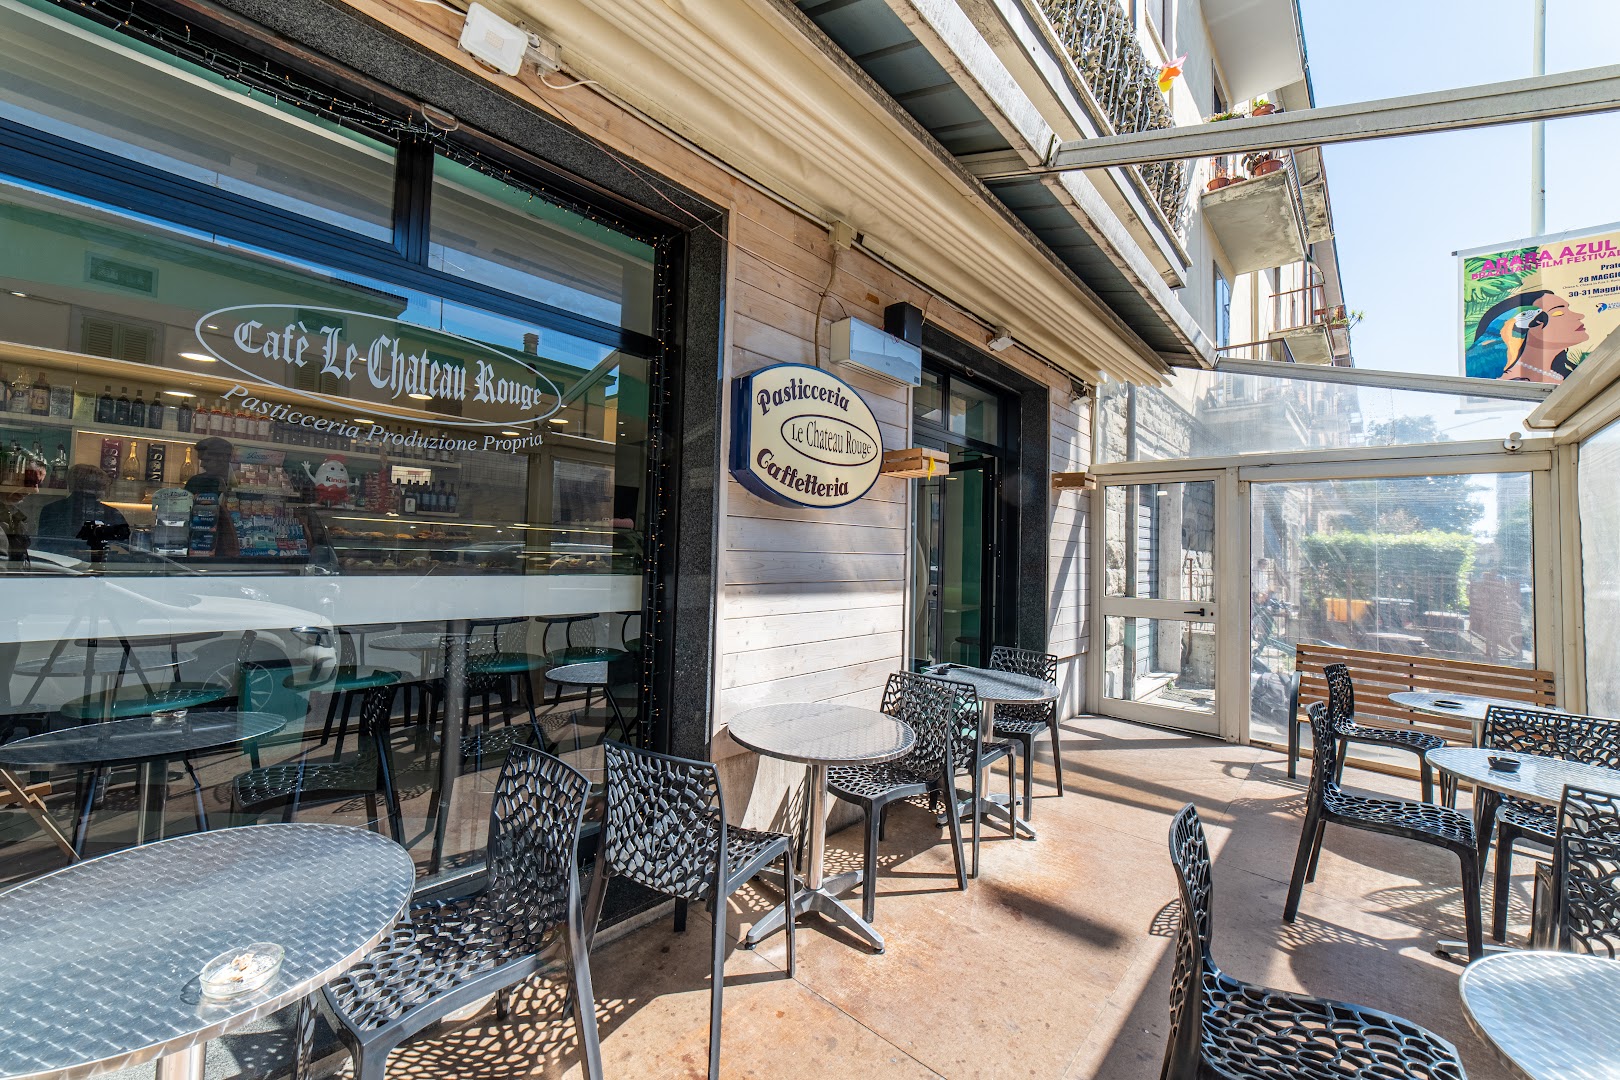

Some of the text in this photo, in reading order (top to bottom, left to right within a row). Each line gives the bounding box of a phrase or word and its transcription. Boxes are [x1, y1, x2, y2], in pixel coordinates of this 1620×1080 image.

[1472, 264, 1532, 280] BRAZILIAN
[1536, 259, 1563, 270] FILM
[1482, 240, 1617, 271] ARARA AZUL
[1568, 289, 1591, 297] 30-31
[233, 319, 543, 410] Cafè Le Chateau Rouge
[756, 378, 850, 416] Pasticceria
[220, 383, 544, 454] Pasticceria Produzione Propria
[791, 420, 872, 459] Le Chateau Rouge
[756, 448, 849, 497] Caffetteria
